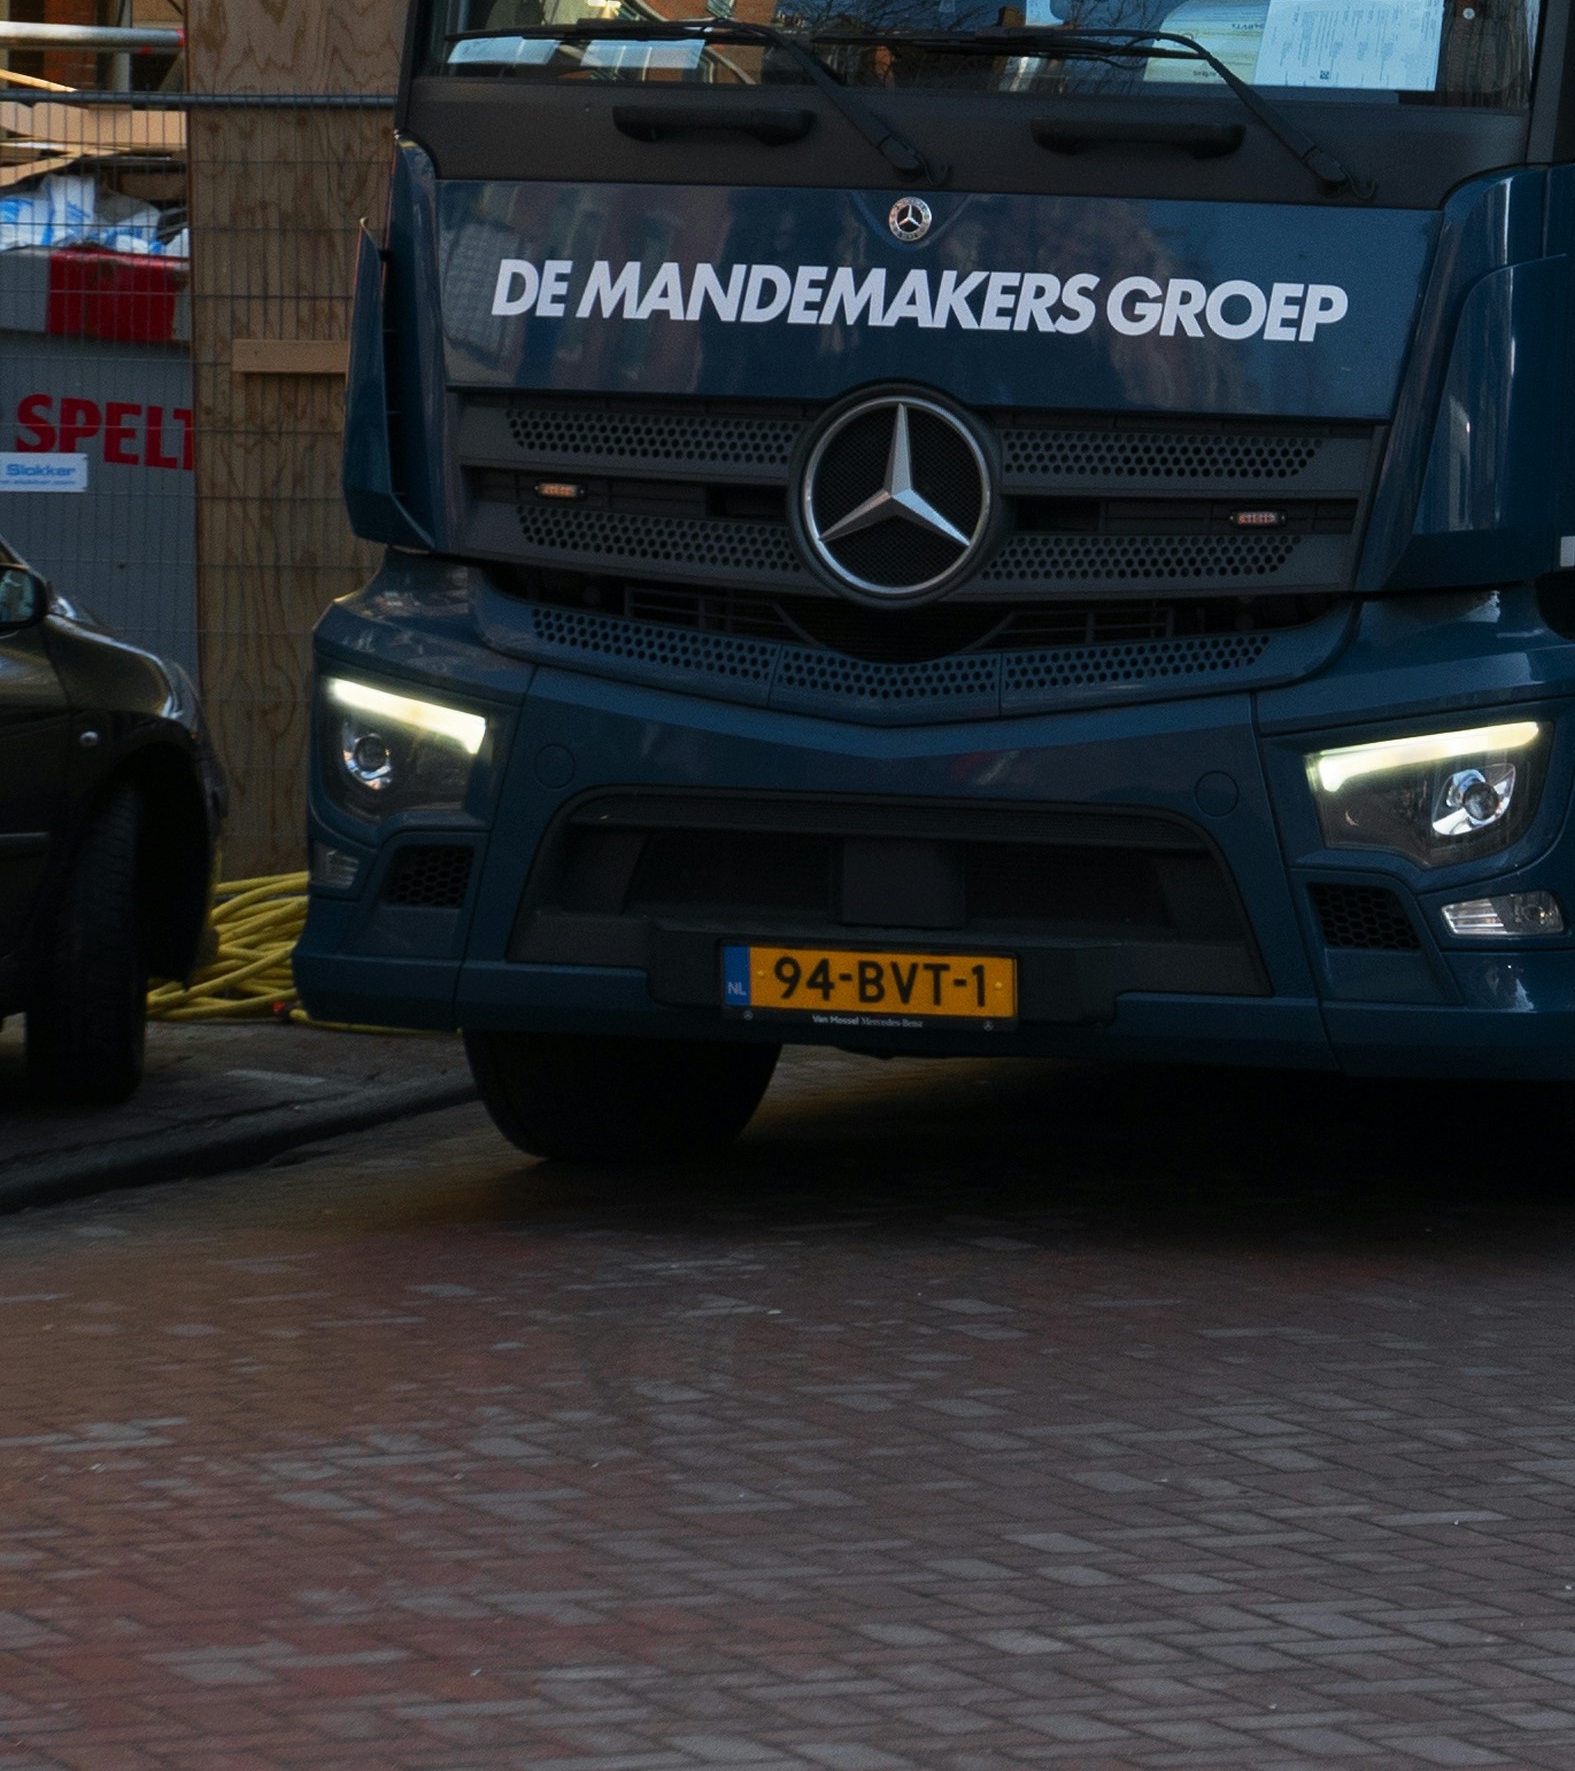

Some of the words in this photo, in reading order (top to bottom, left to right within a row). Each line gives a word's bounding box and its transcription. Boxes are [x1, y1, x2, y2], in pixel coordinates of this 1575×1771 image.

[492, 259, 573, 317] DE
[576, 260, 1100, 334] MANDEMAKERS
[1106, 276, 1348, 343] GROEP
[727, 980, 748, 996] NL
[773, 955, 986, 1008] 94-BVT-1
[811, 1014, 829, 1024] Van
